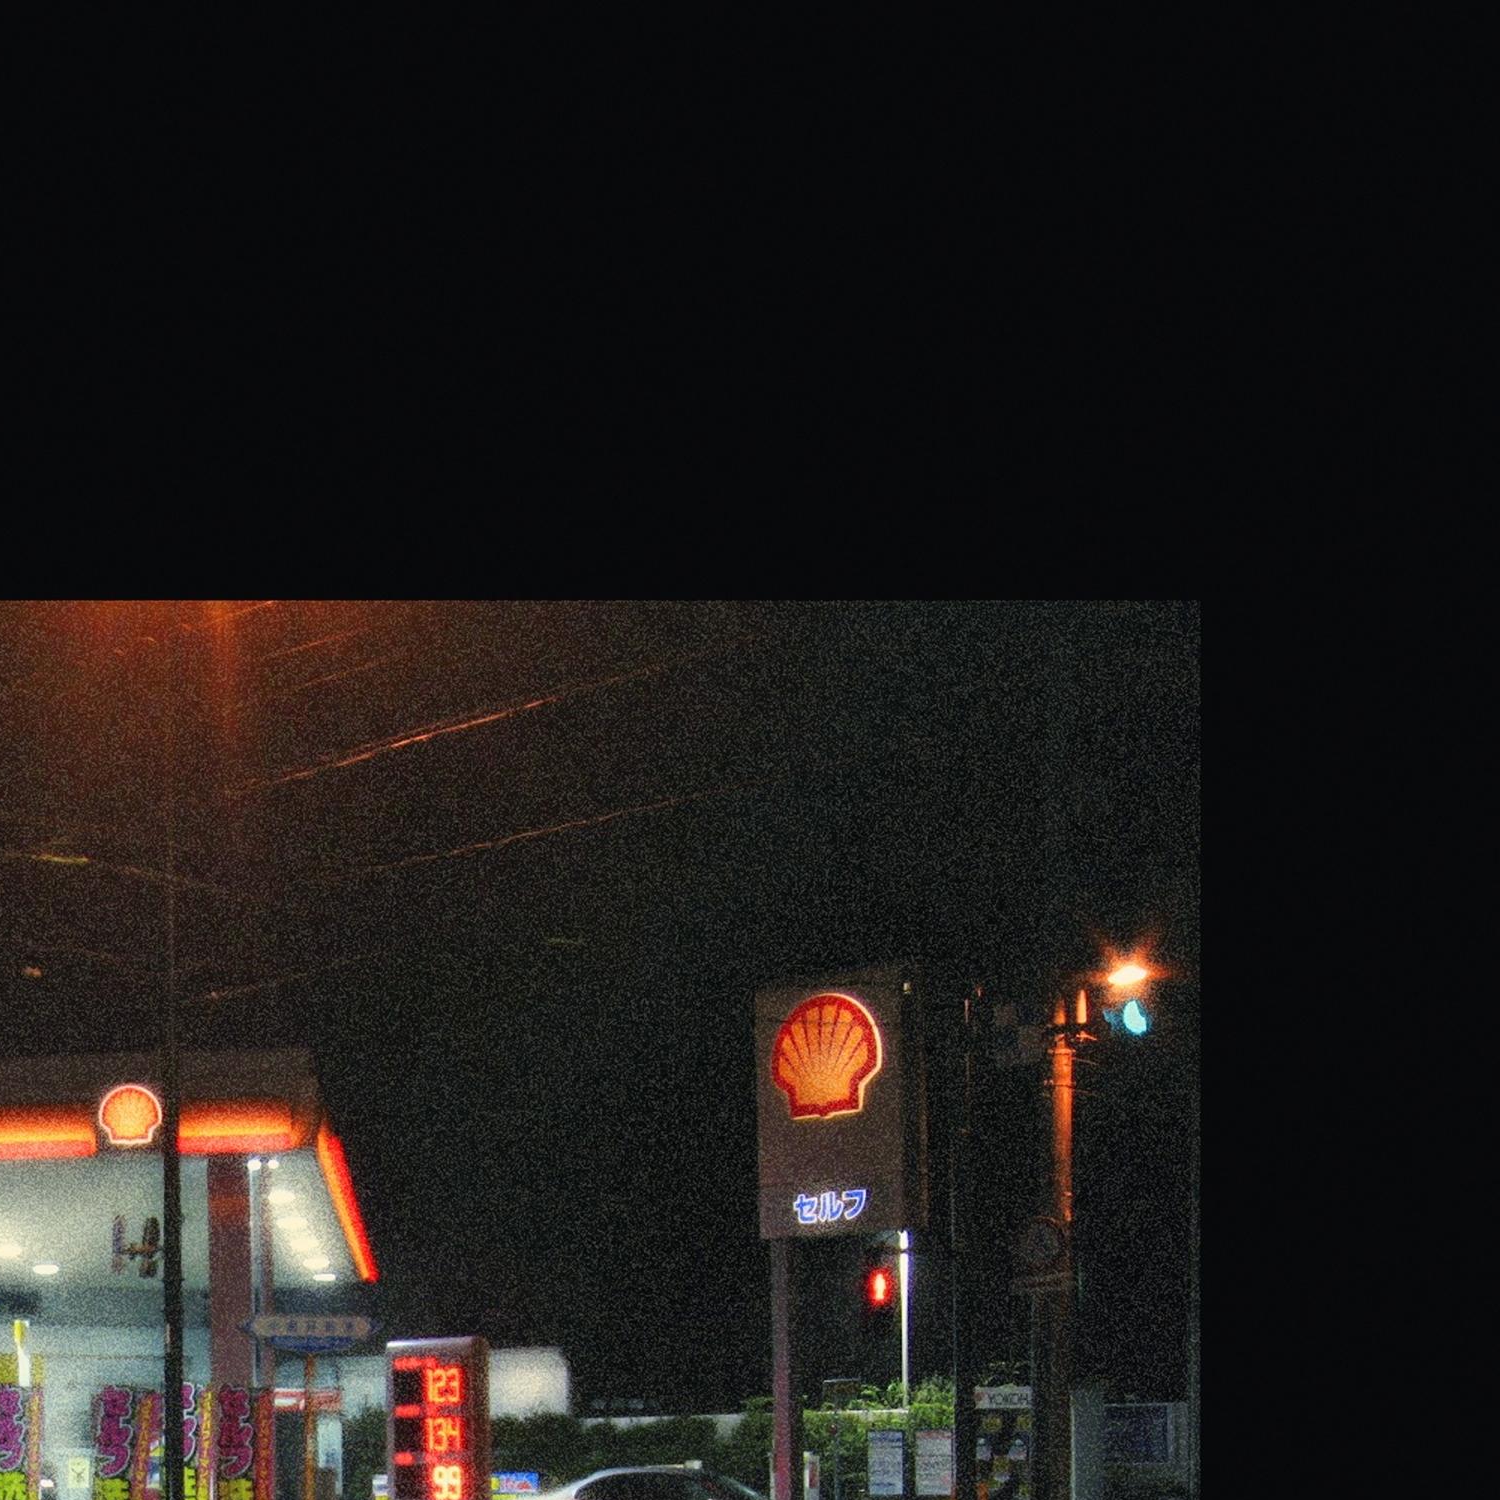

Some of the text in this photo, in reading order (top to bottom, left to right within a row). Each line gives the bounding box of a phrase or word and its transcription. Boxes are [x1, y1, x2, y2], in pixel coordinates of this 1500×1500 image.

[793, 1188, 868, 1224] セルフ
[425, 1367, 461, 1404] 123
[425, 1416, 461, 1452] 134
[432, 1465, 462, 1500] 99
